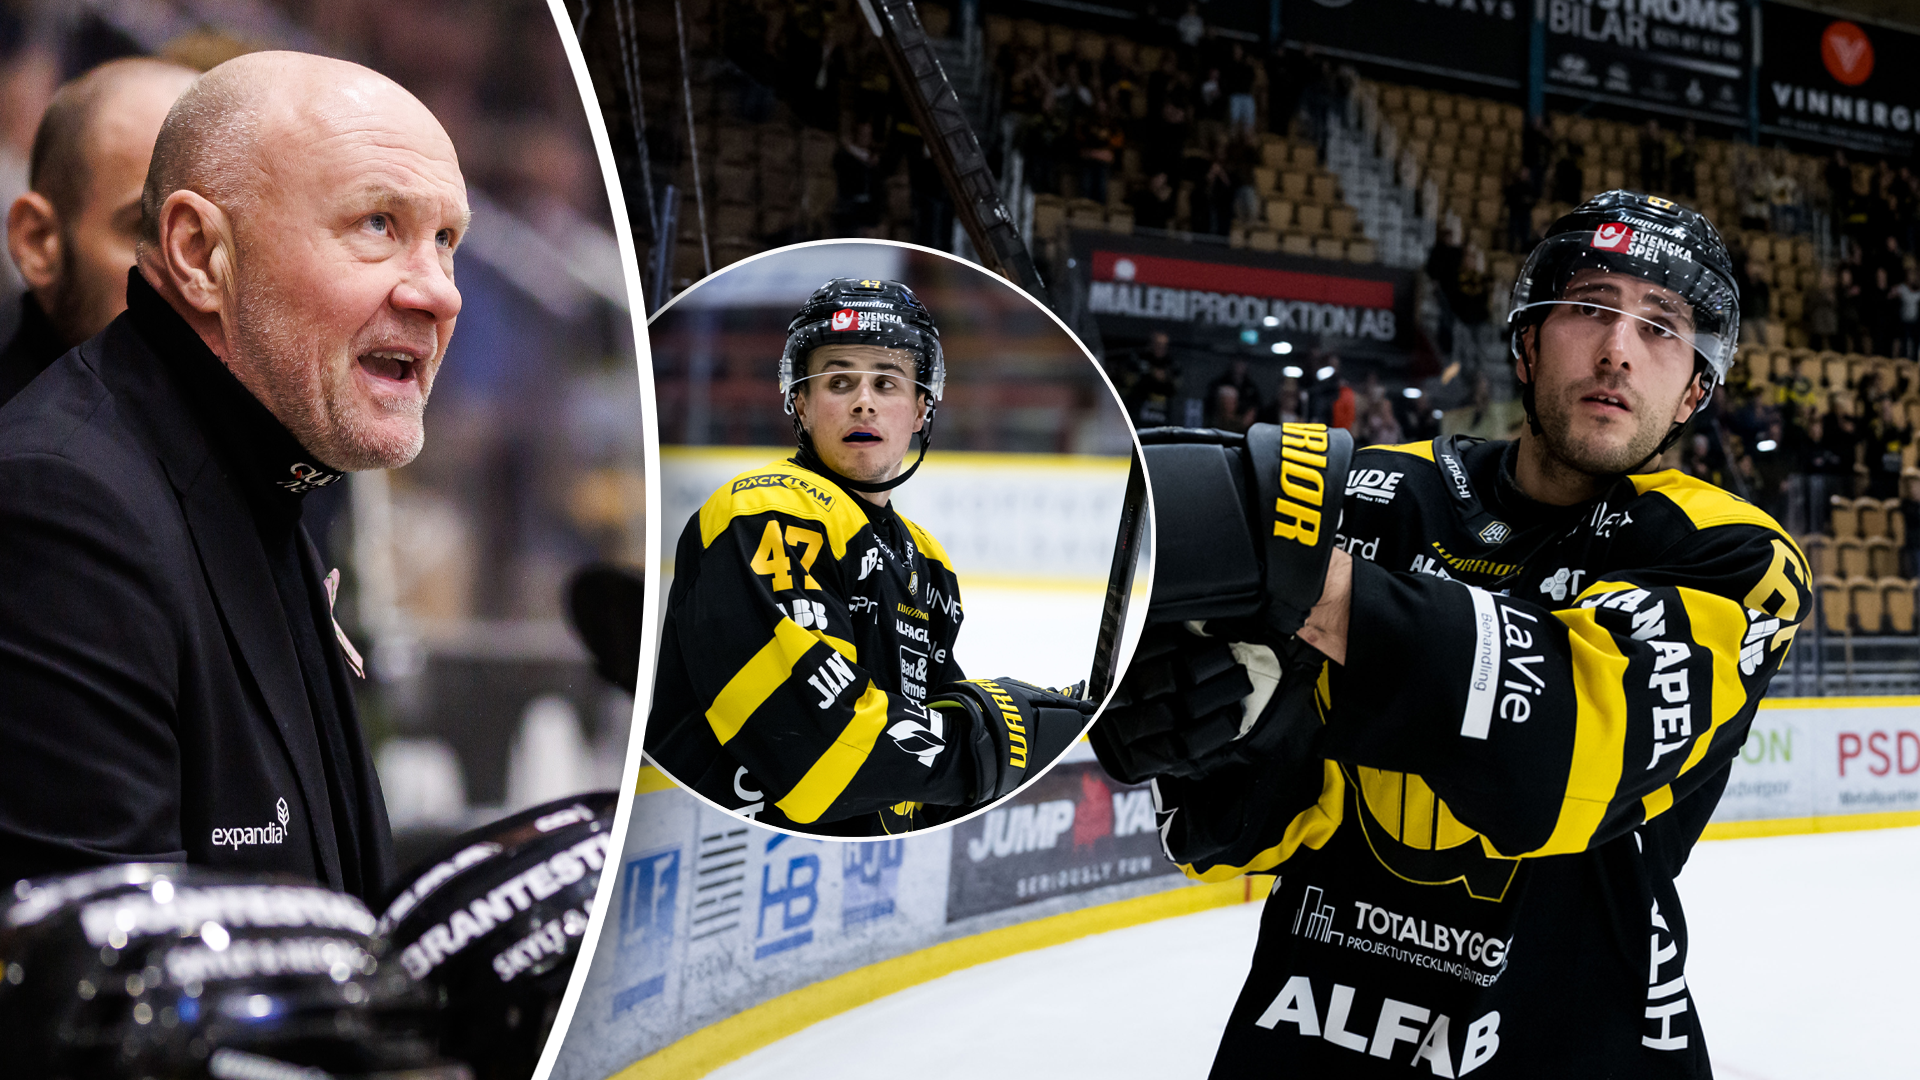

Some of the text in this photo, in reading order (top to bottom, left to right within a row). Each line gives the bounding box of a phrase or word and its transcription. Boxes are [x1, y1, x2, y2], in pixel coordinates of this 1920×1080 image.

[1550, 2, 1648, 49] BILAR
[1618, 215, 1687, 241] WARRIOR
[1626, 243, 1659, 264] SPEL
[1630, 231, 1692, 263] SVENSKA
[860, 279, 881, 289] 47
[843, 301, 894, 310] WARRIOR
[857, 311, 902, 324] SVENSKA
[857, 321, 882, 331] SPEL
[1359, 308, 1396, 341] AB
[735, 475, 833, 506] DÄCK TEAM
[1441, 454, 1472, 499] HITACHI
[750, 519, 824, 592] 47
[1473, 612, 1494, 692] Behandling
[1500, 604, 1546, 724] LaVie
[901, 658, 927, 682] Bad &
[211, 820, 283, 851] expandia
[967, 799, 1076, 863] JUMP
[1111, 788, 1158, 838] YA
[1016, 854, 1153, 898] SERIOUSLY FUN
[1354, 900, 1513, 968] TOTALBYGG
